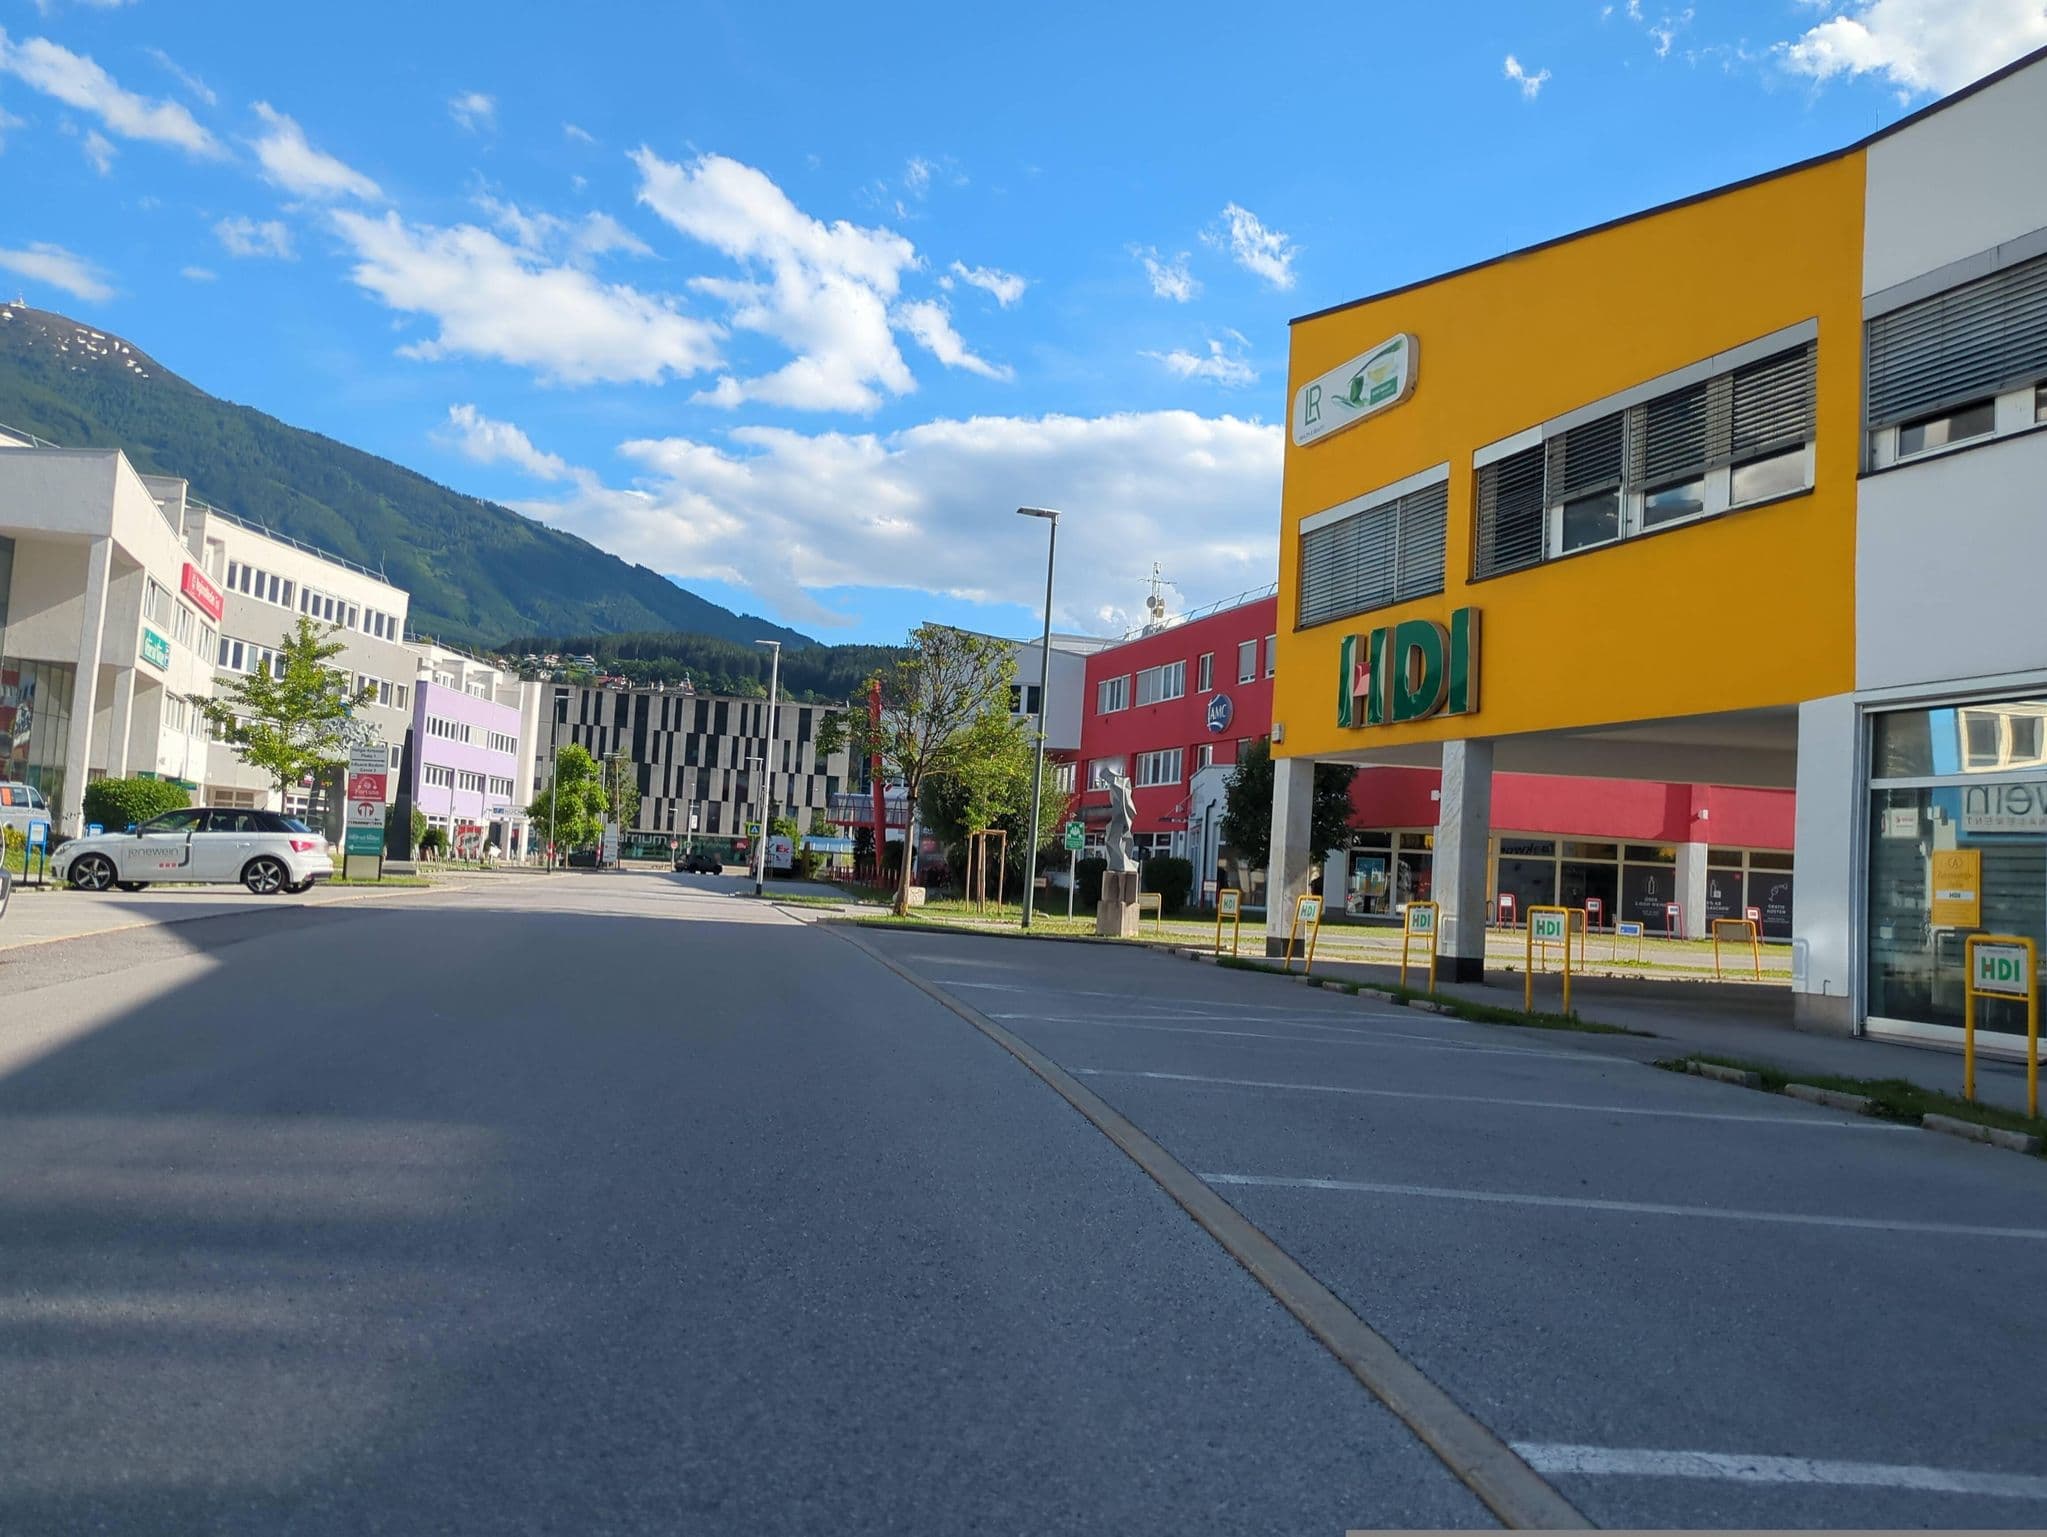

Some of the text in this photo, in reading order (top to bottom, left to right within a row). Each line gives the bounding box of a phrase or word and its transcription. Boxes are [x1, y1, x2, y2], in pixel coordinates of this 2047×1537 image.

[1337, 607, 1481, 728] HDI
[1210, 703, 1227, 720] AMC
[1300, 905, 1316, 917] HDI
[1412, 914, 1431, 927] HDI
[1536, 920, 1560, 936] HDI
[1981, 956, 2020, 982] HDI
